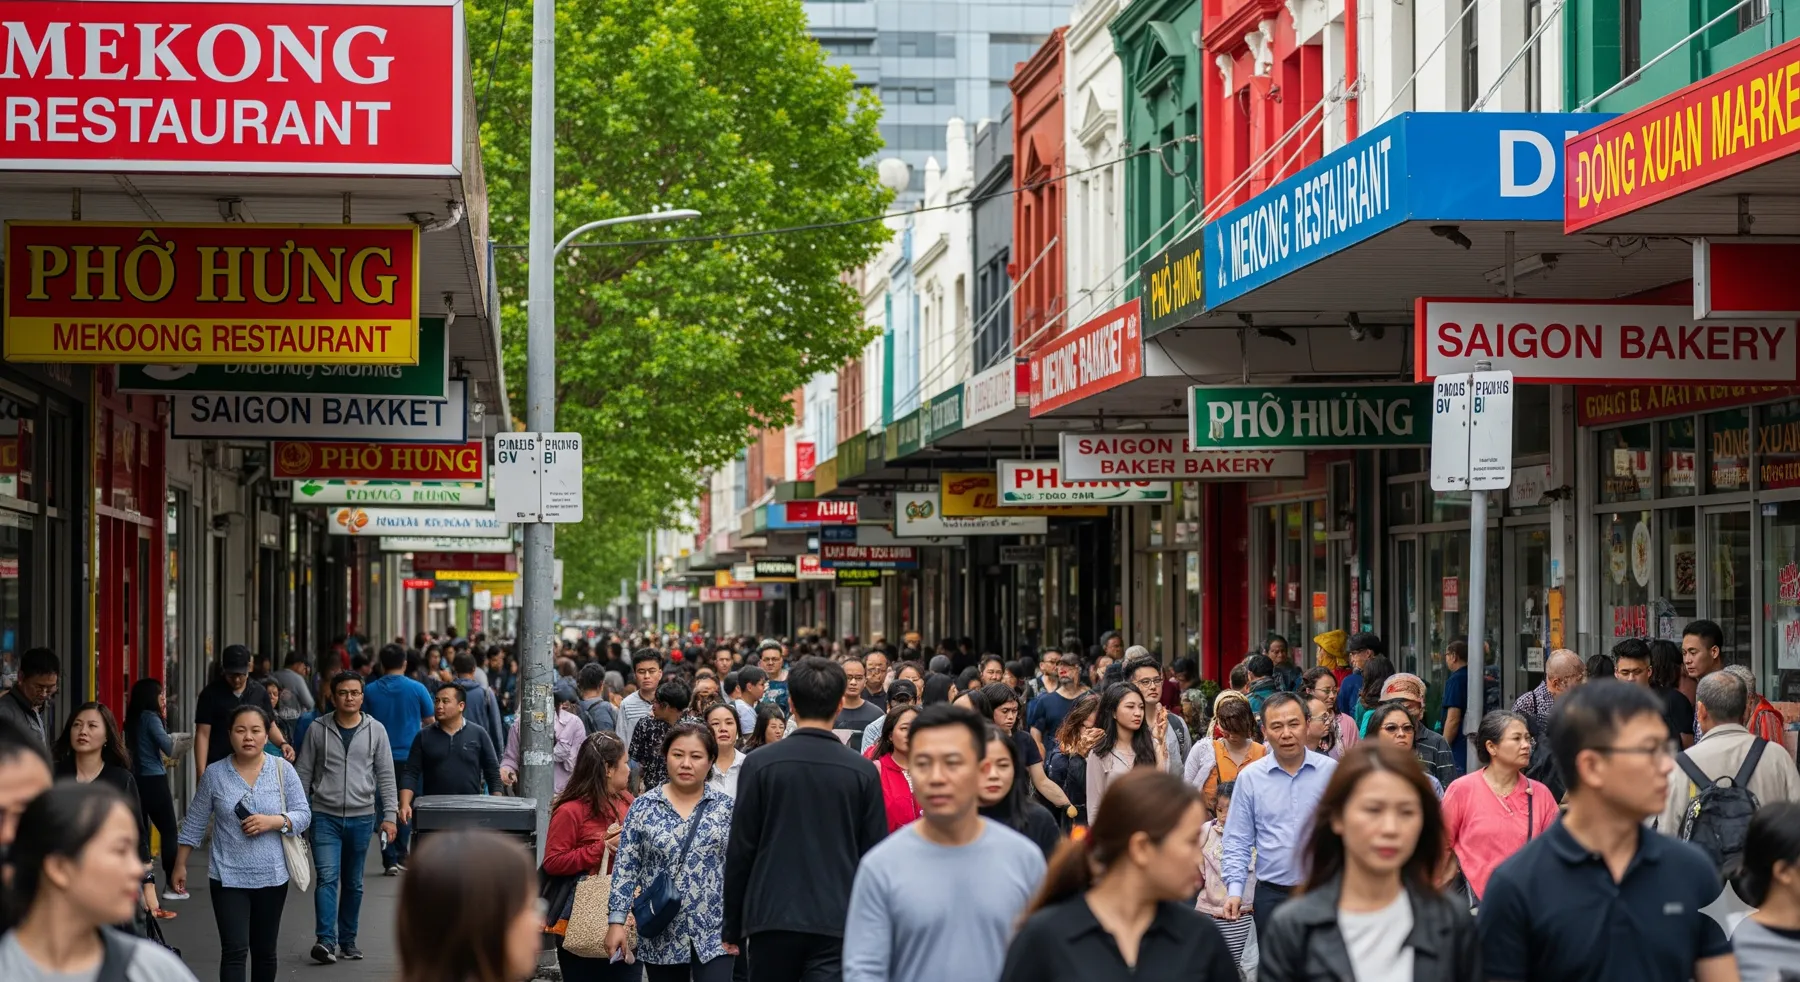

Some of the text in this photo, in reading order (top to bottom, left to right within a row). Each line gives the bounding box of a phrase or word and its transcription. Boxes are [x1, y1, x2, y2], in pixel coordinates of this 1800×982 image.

[0, 21, 395, 84] MEKONG
[5, 96, 391, 146] RESTAURANT
[1640, 102, 1702, 187] XUAN
[1230, 135, 1391, 283] MEKONG RESTAURANT
[54, 323, 391, 353] MEKOONG RESTAURANT
[1437, 322, 1787, 361] SAIGON BAKERY
[191, 394, 447, 426] SAIGON BAKKET
[1079, 438, 1173, 454] SAIGON
[1101, 458, 1275, 474] BAKER BAKERY
